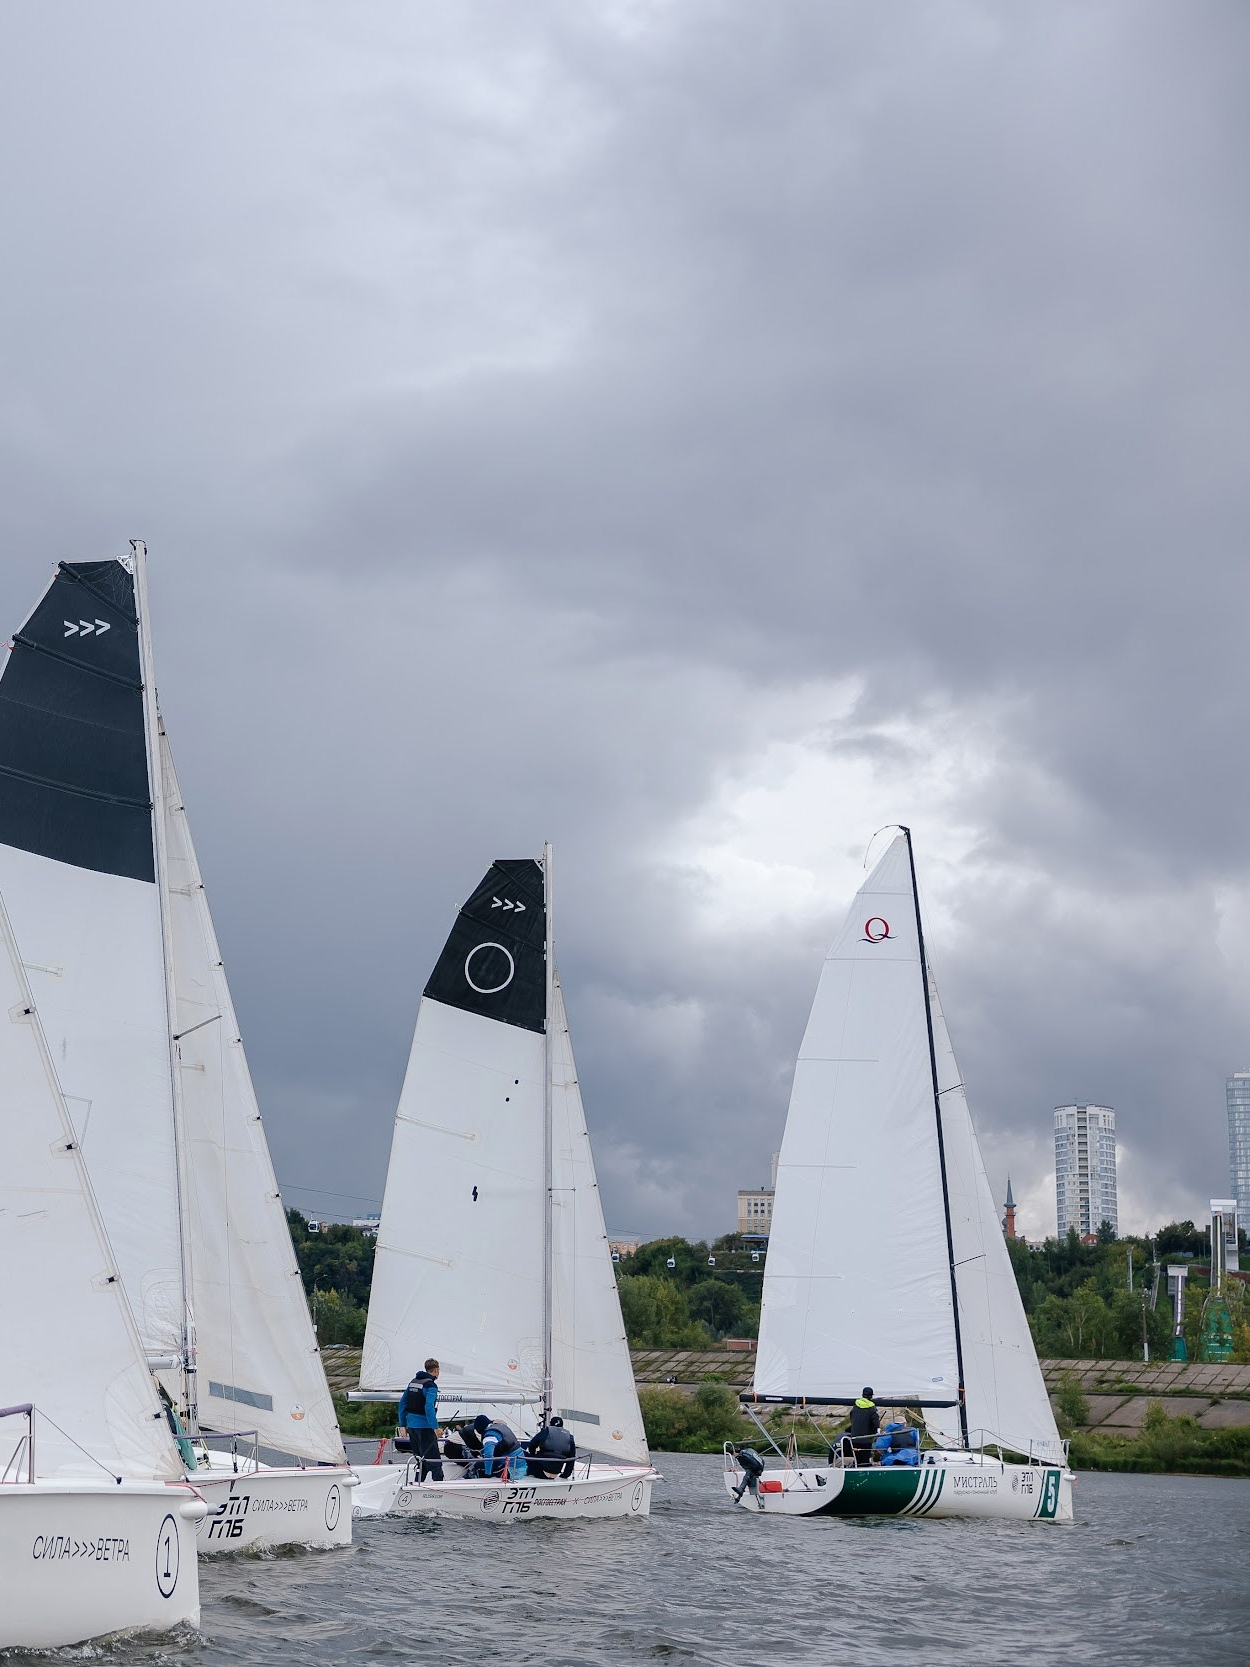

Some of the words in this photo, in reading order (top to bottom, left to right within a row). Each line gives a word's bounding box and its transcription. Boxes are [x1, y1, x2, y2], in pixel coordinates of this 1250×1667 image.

[953, 1476, 998, 1488] МИСТРАЛЬ
[1047, 1475, 1056, 1513] 5
[401, 1495, 408, 1503] 4
[634, 1487, 640, 1503] 4
[329, 1496, 337, 1520] 7
[32, 1535, 71, 1559] СИЛА
[95, 1538, 130, 1561] ВЕТРА
[163, 1536, 171, 1578] 1
